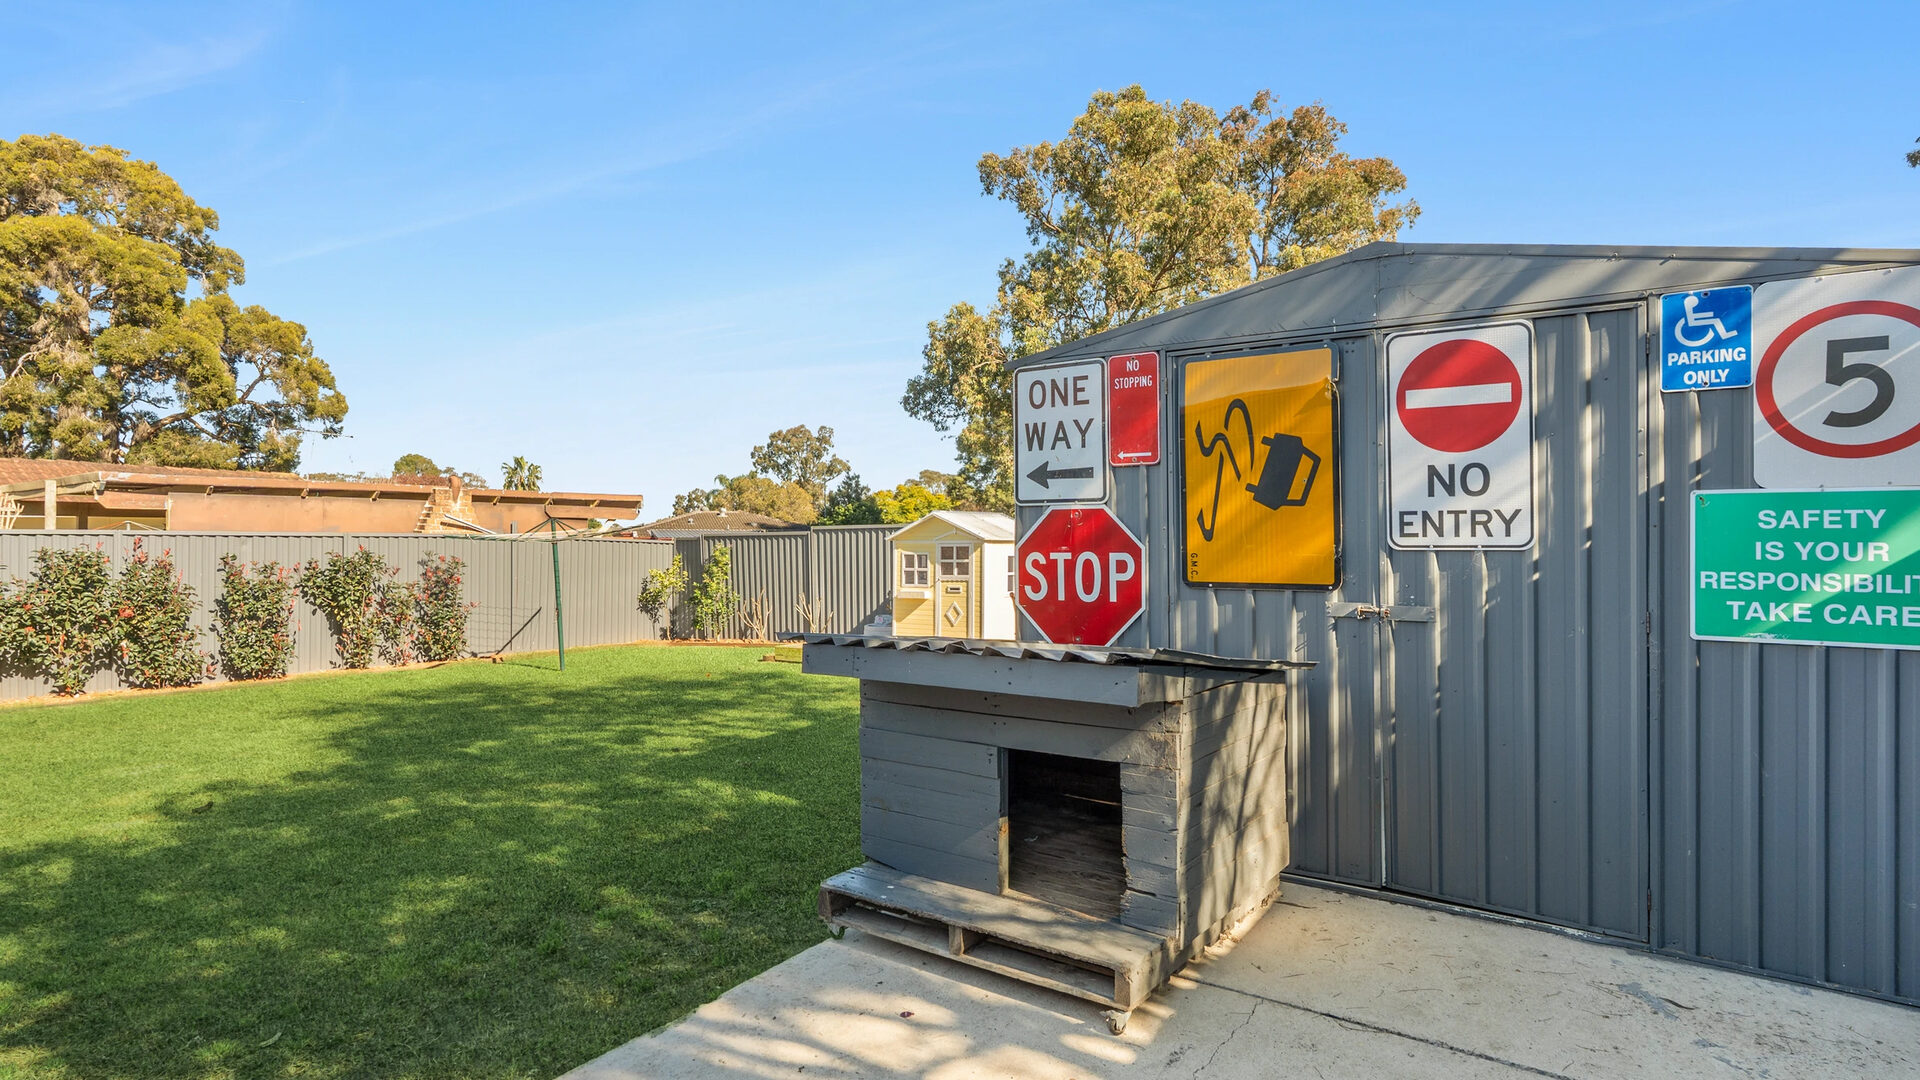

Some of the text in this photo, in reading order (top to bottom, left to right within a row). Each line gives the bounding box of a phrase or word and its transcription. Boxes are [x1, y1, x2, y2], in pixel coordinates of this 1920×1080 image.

[1126, 360, 1140, 372] NO
[1667, 347, 1747, 367] PARKING
[1114, 375, 1153, 390] STOPPING
[1683, 368, 1730, 386] ONLY
[1822, 335, 1895, 428] 5
[1028, 375, 1090, 410] ONE
[1025, 418, 1095, 452] WAY
[1427, 462, 1491, 498] NO
[1398, 508, 1523, 538] ENTRY
[1757, 508, 1887, 530] SAFETY
[1755, 541, 1890, 562] IS YOUR
[1024, 551, 1136, 603] STOP
[1726, 601, 1920, 627] TAKE CARE
